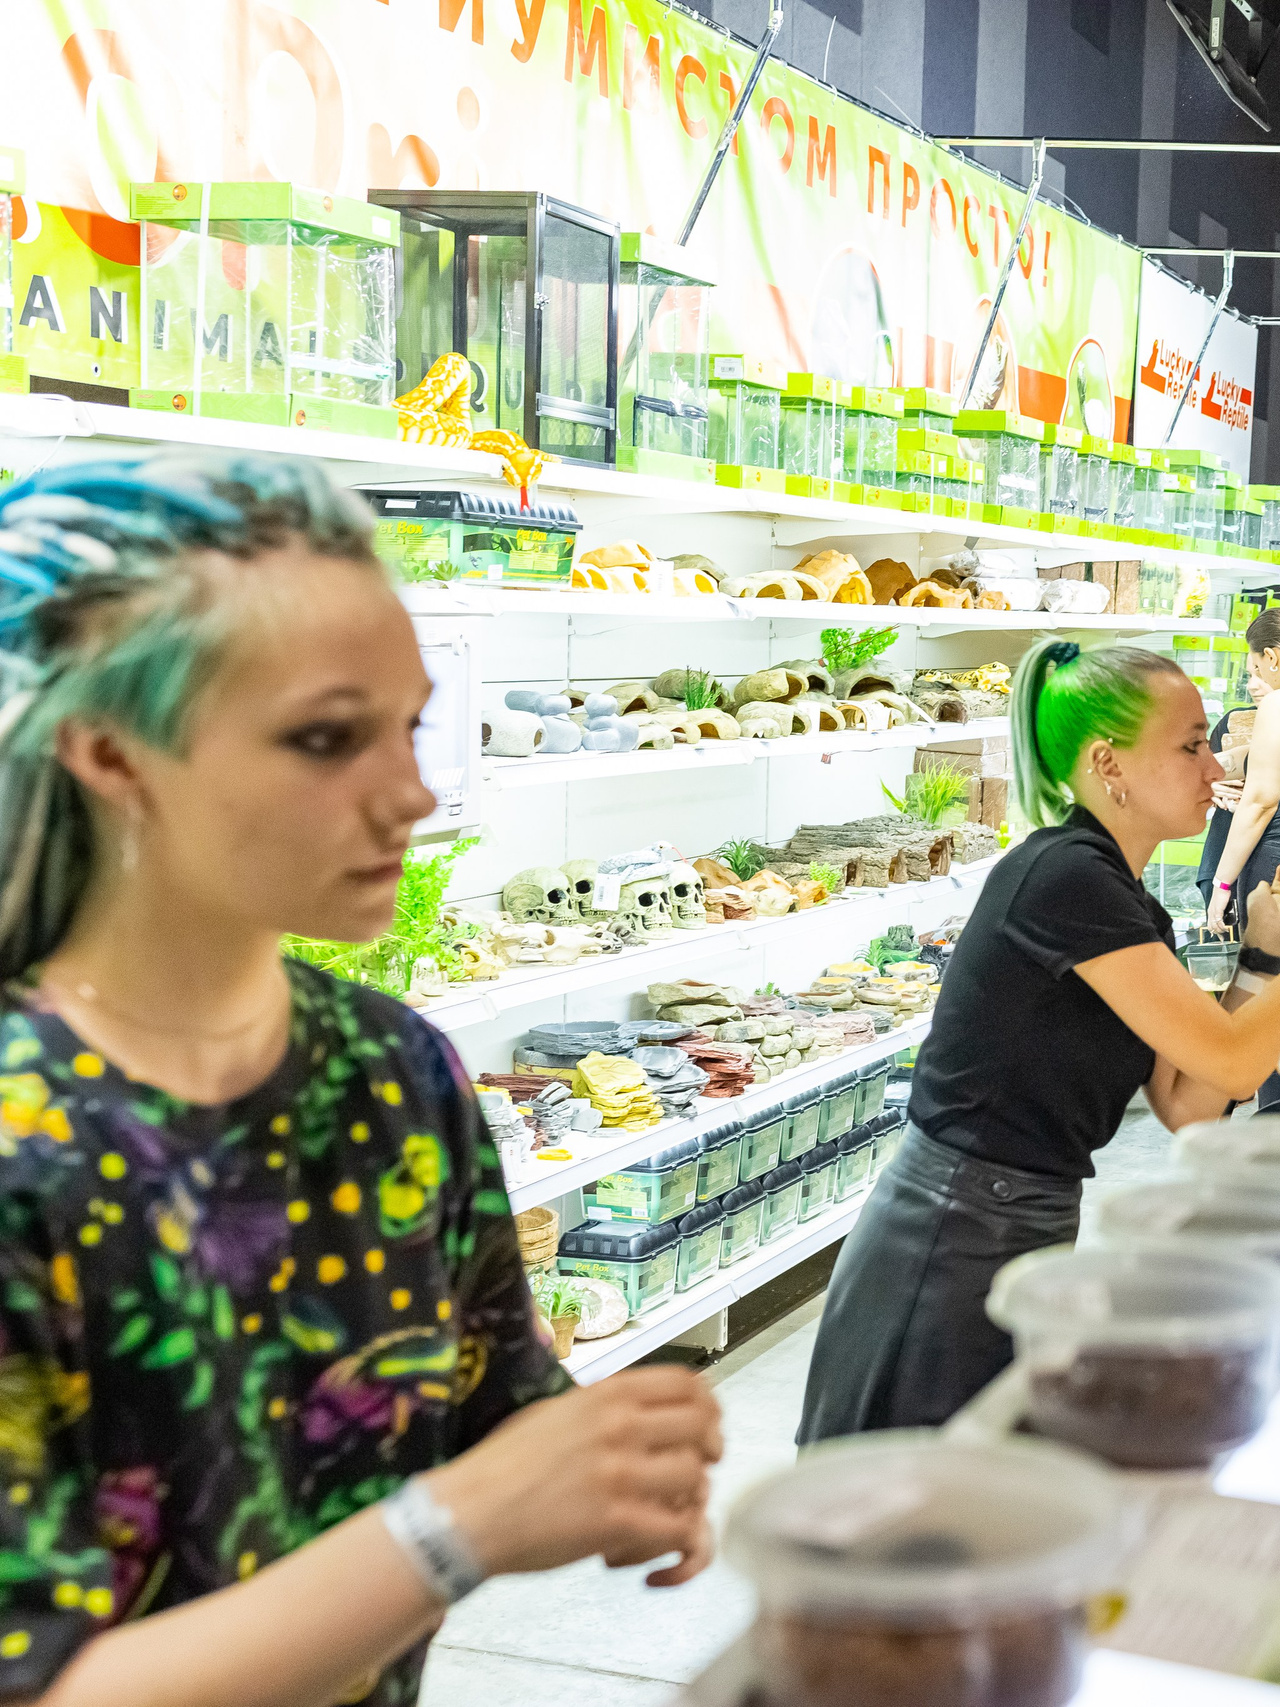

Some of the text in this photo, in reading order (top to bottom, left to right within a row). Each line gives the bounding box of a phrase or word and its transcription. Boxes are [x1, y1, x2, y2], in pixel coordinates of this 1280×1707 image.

[867, 144, 1051, 288] ПРОСТО!
[1160, 339, 1187, 381] Lucky
[1217, 371, 1241, 407] Lucky
[1221, 399, 1249, 431] Reptile
[397, 520, 424, 534] Box
[575, 1262, 610, 1272] Pet Box
